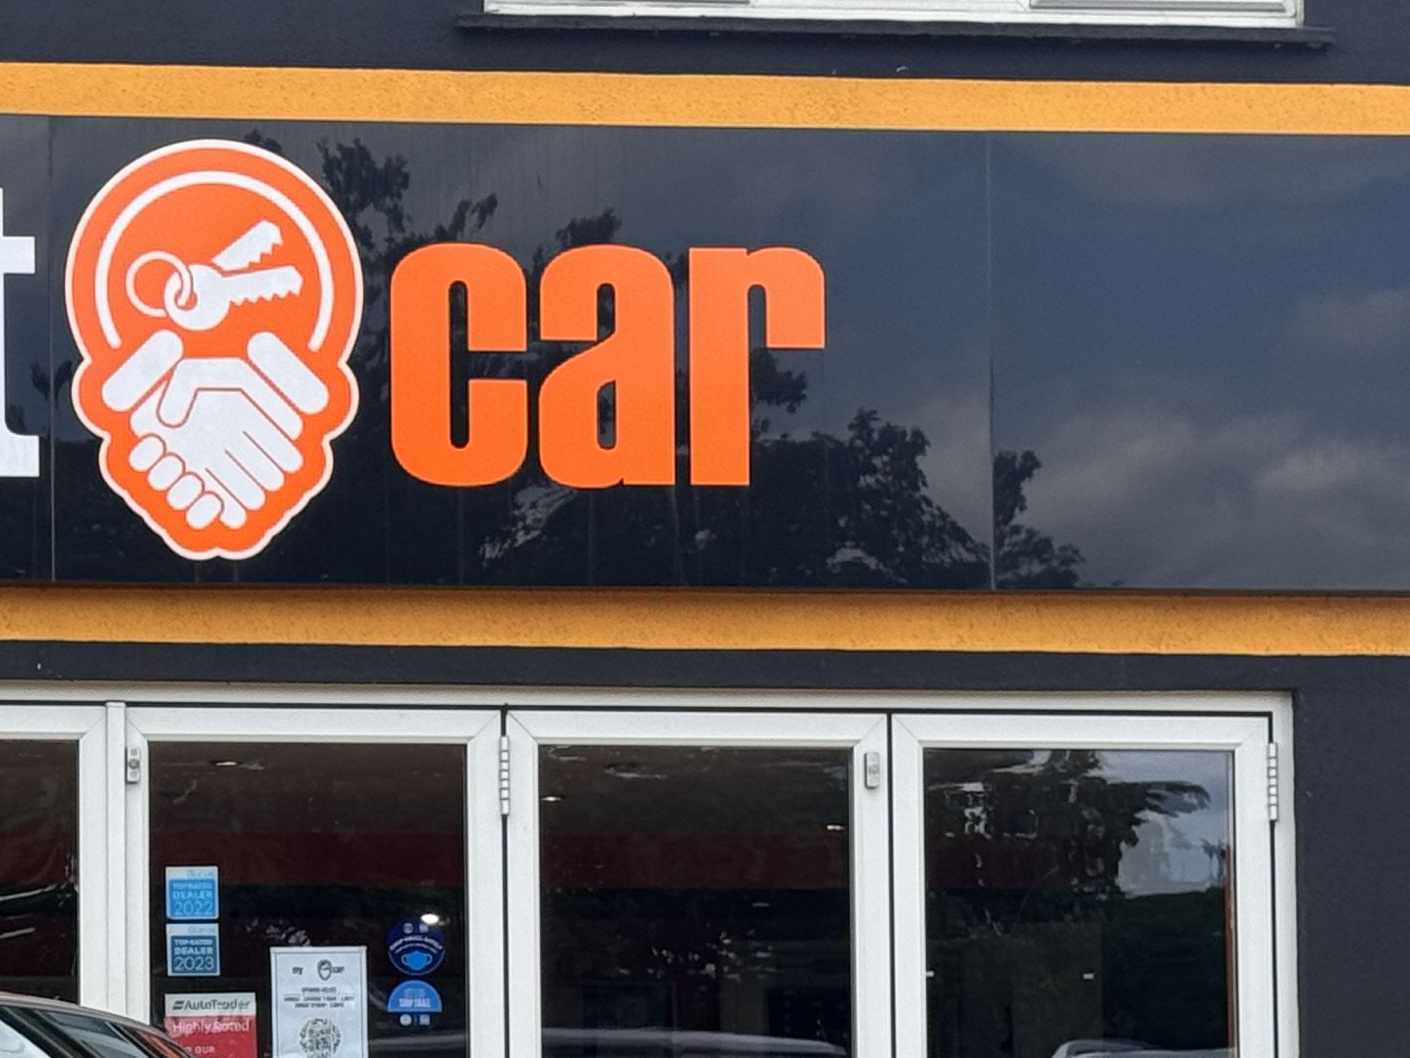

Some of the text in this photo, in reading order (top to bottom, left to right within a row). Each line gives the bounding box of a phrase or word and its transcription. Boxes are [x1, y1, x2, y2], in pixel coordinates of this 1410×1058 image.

[389, 242, 827, 489] car
[172, 890, 213, 900] DEALER
[174, 900, 213, 916] 2022
[174, 946, 214, 956] DEALER
[174, 956, 215, 971] 2023
